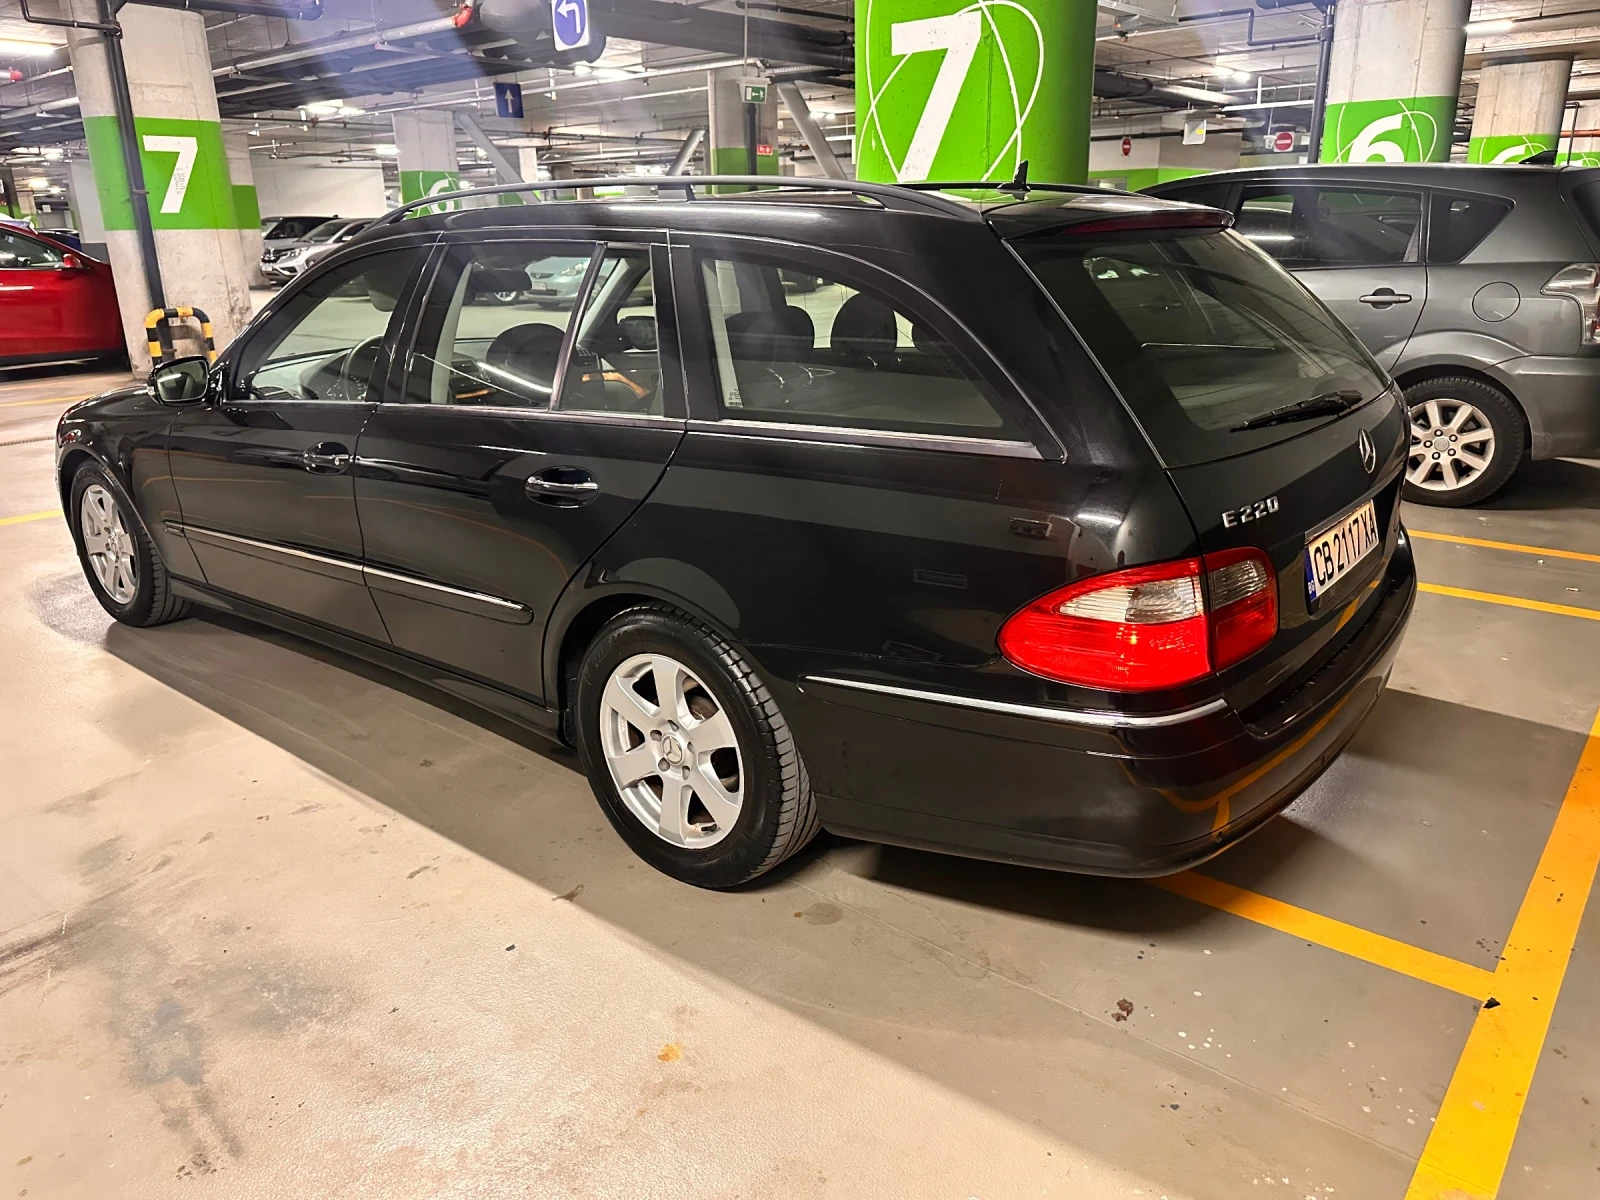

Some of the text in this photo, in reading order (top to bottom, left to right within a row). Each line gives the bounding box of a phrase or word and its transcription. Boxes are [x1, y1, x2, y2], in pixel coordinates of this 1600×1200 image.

[891, 10, 982, 183] 7
[142, 135, 198, 213] 7
[428, 179, 455, 215] 6
[1314, 507, 1377, 587] CB 2117 XA
